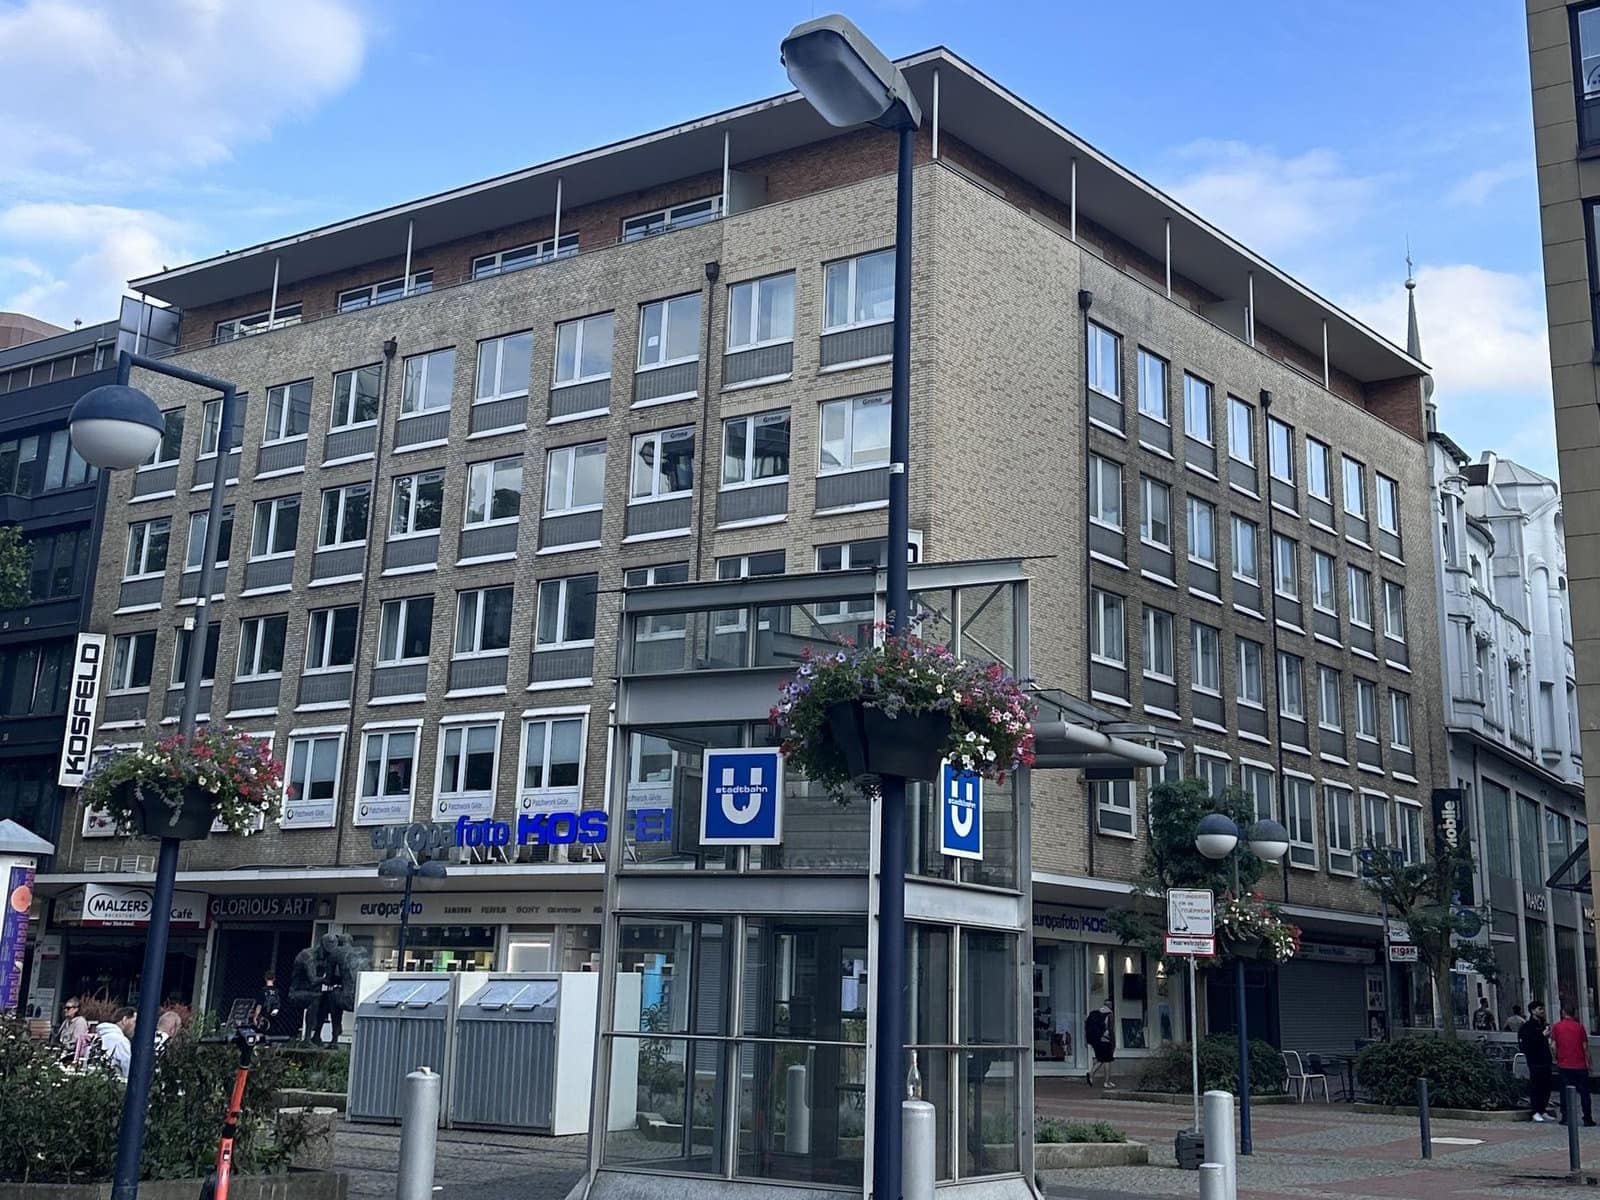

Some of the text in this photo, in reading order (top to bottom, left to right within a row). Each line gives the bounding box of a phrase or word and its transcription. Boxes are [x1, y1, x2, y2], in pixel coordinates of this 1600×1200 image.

[65, 643, 101, 775] KOSFELD
[715, 785, 769, 794] stadtbahn
[721, 767, 763, 825] U
[947, 797, 977, 809] stadtbahn
[951, 780, 974, 838] U
[94, 899, 149, 912] MALZERS
[210, 897, 313, 917] GLORIOUS ART
[1525, 891, 1547, 912] MANGO
[170, 908, 193, 920] Café
[516, 906, 541, 914] SONY
